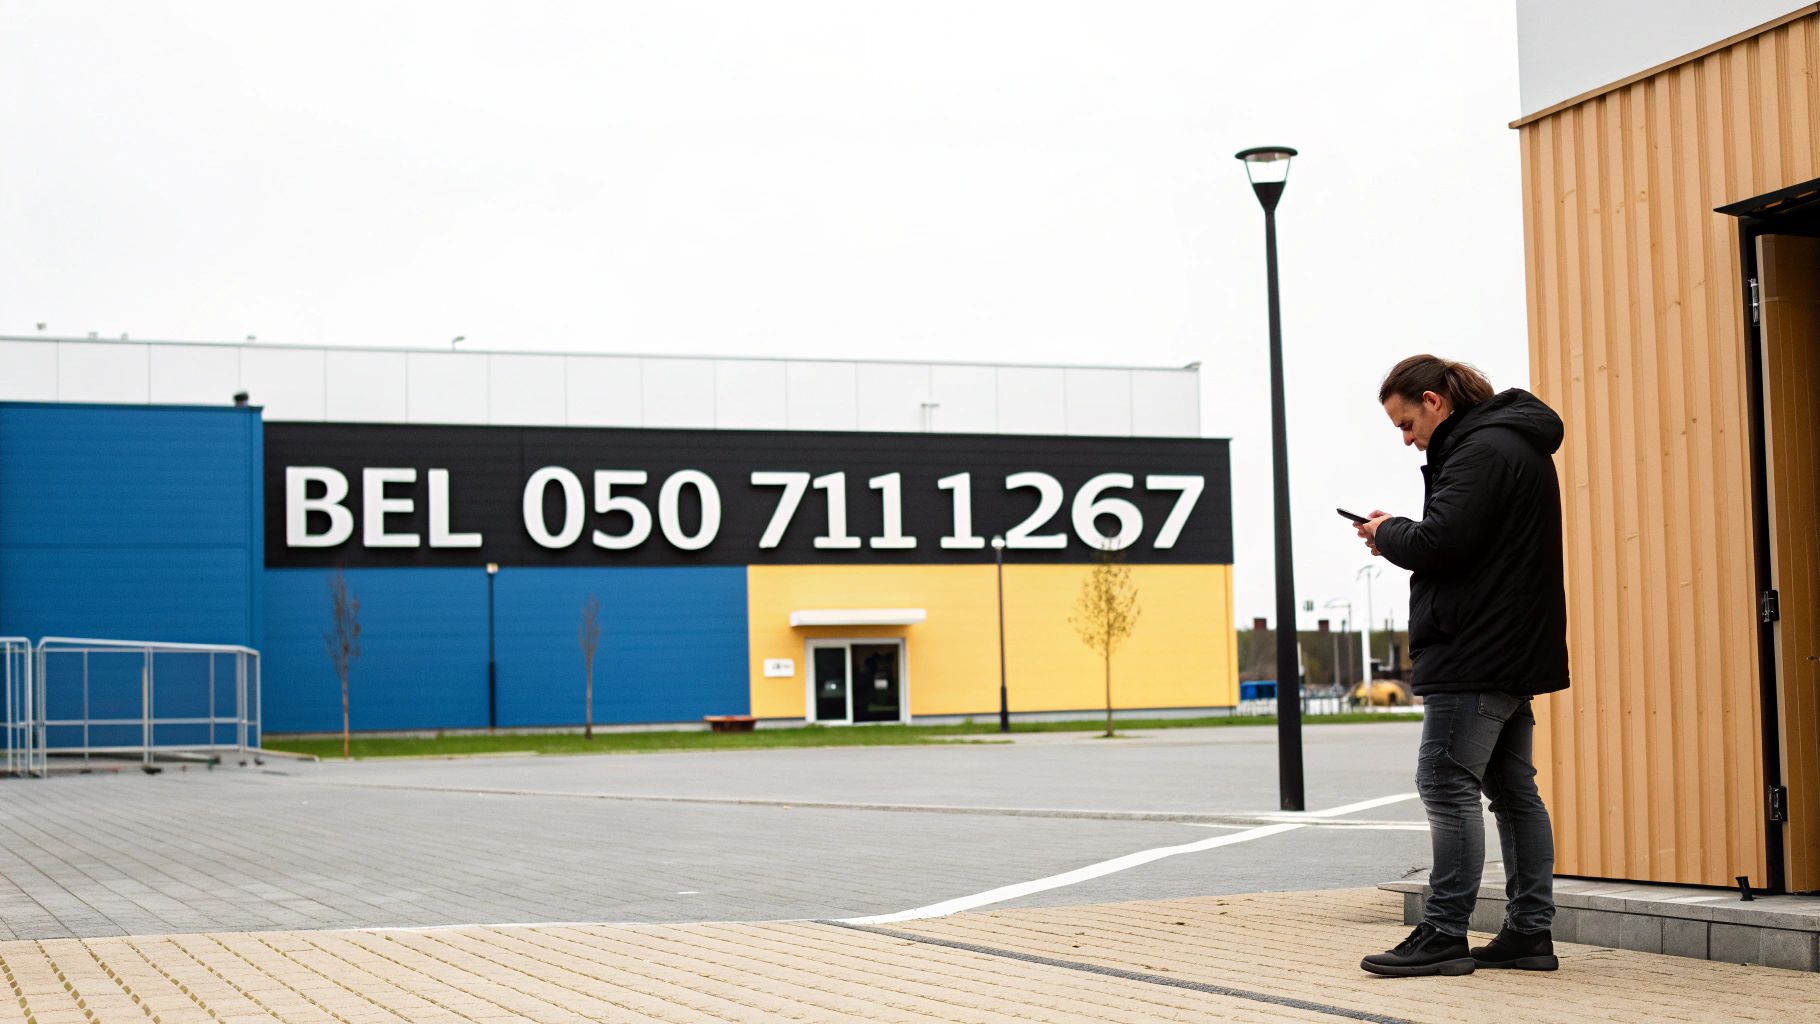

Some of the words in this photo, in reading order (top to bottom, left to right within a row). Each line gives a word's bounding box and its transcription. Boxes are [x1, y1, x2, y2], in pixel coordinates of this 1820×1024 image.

[285, 466, 483, 548] BEL
[522, 466, 722, 550] 050
[750, 471, 917, 549] 711
